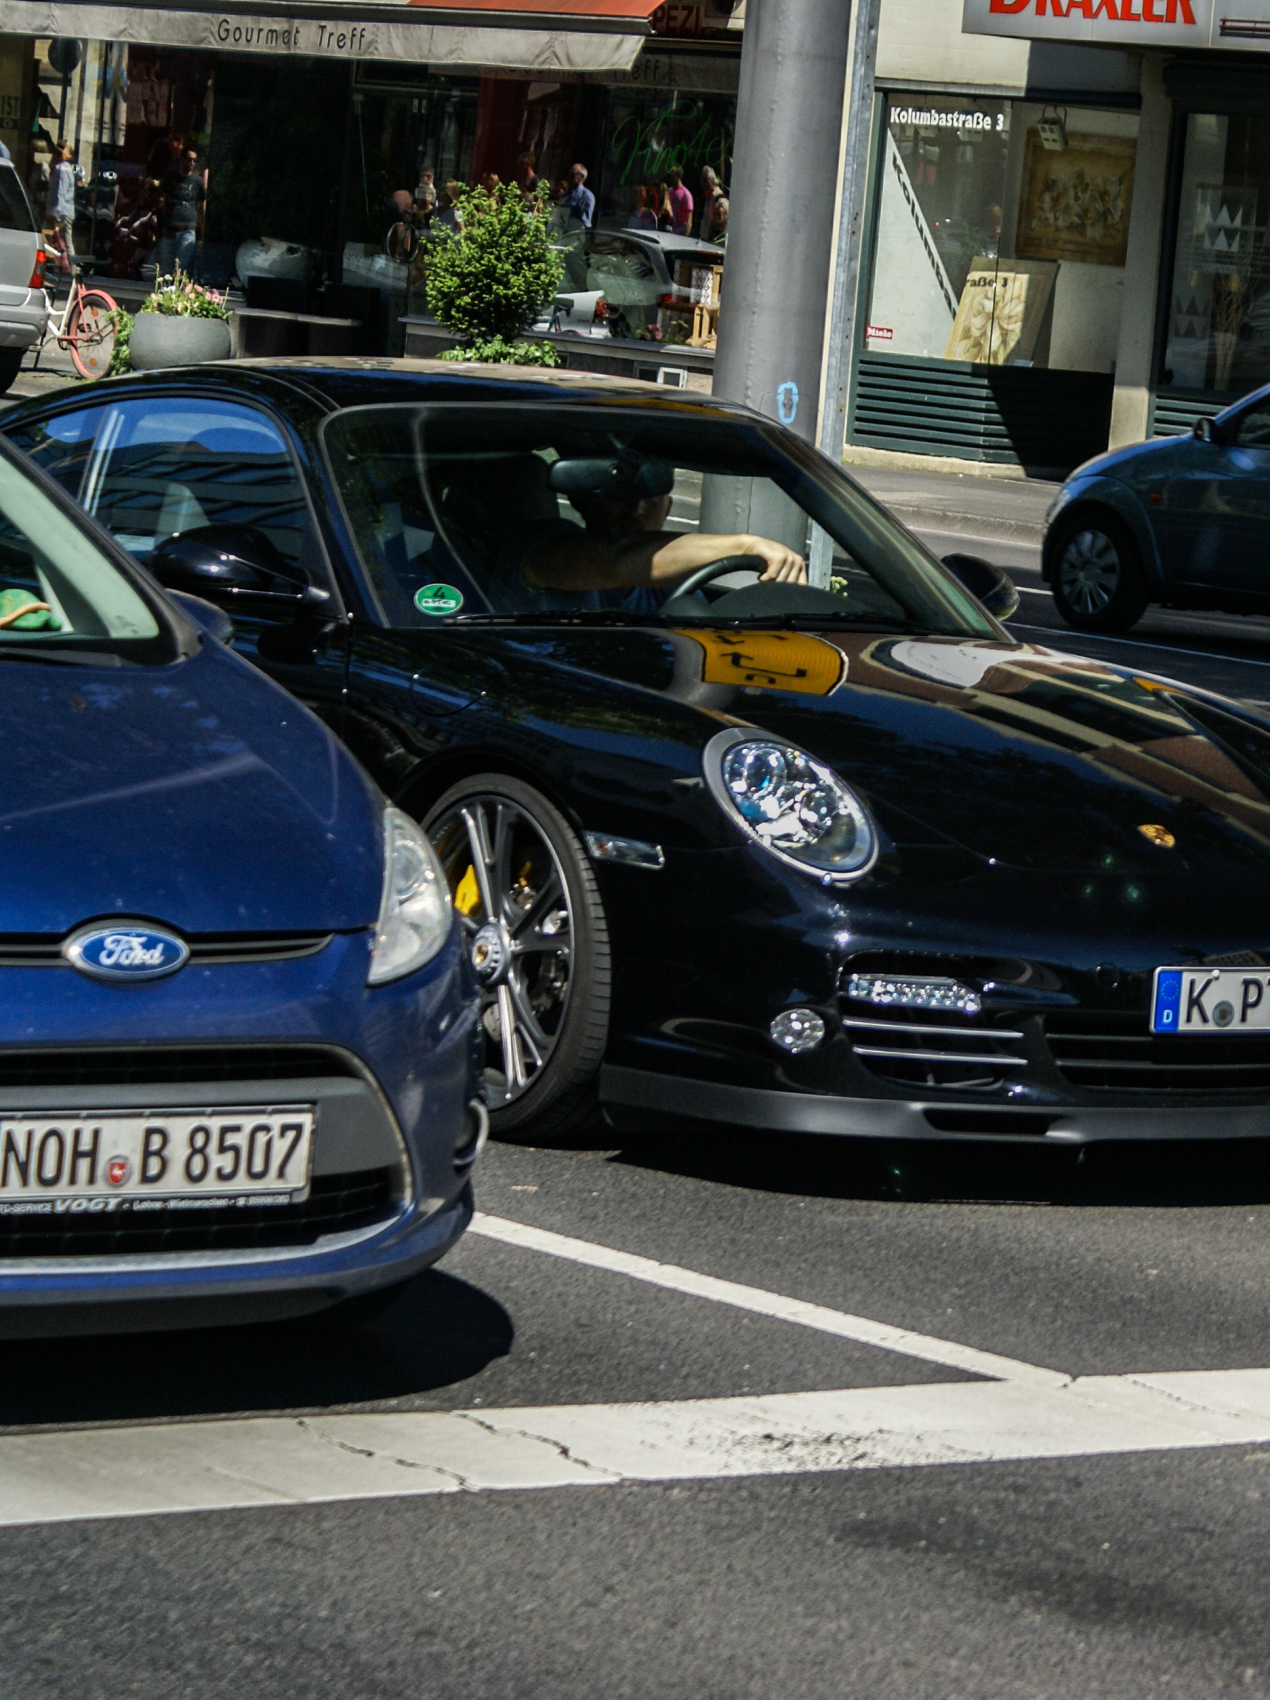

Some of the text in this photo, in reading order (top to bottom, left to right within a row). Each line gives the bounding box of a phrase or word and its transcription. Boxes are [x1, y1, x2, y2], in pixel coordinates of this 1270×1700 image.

[217, 18, 366, 50] Gourmet Treff
[890, 107, 1004, 131] Kolumbastraße 3
[867, 327, 893, 339] Miele
[433, 586, 445, 599] 4
[100, 934, 165, 966] Ford
[1186, 977, 1213, 1024] K
[1162, 1009, 1173, 1024] D
[1, 1122, 304, 1188] NOH B 8507
[54, 1198, 122, 1213] VOGT
